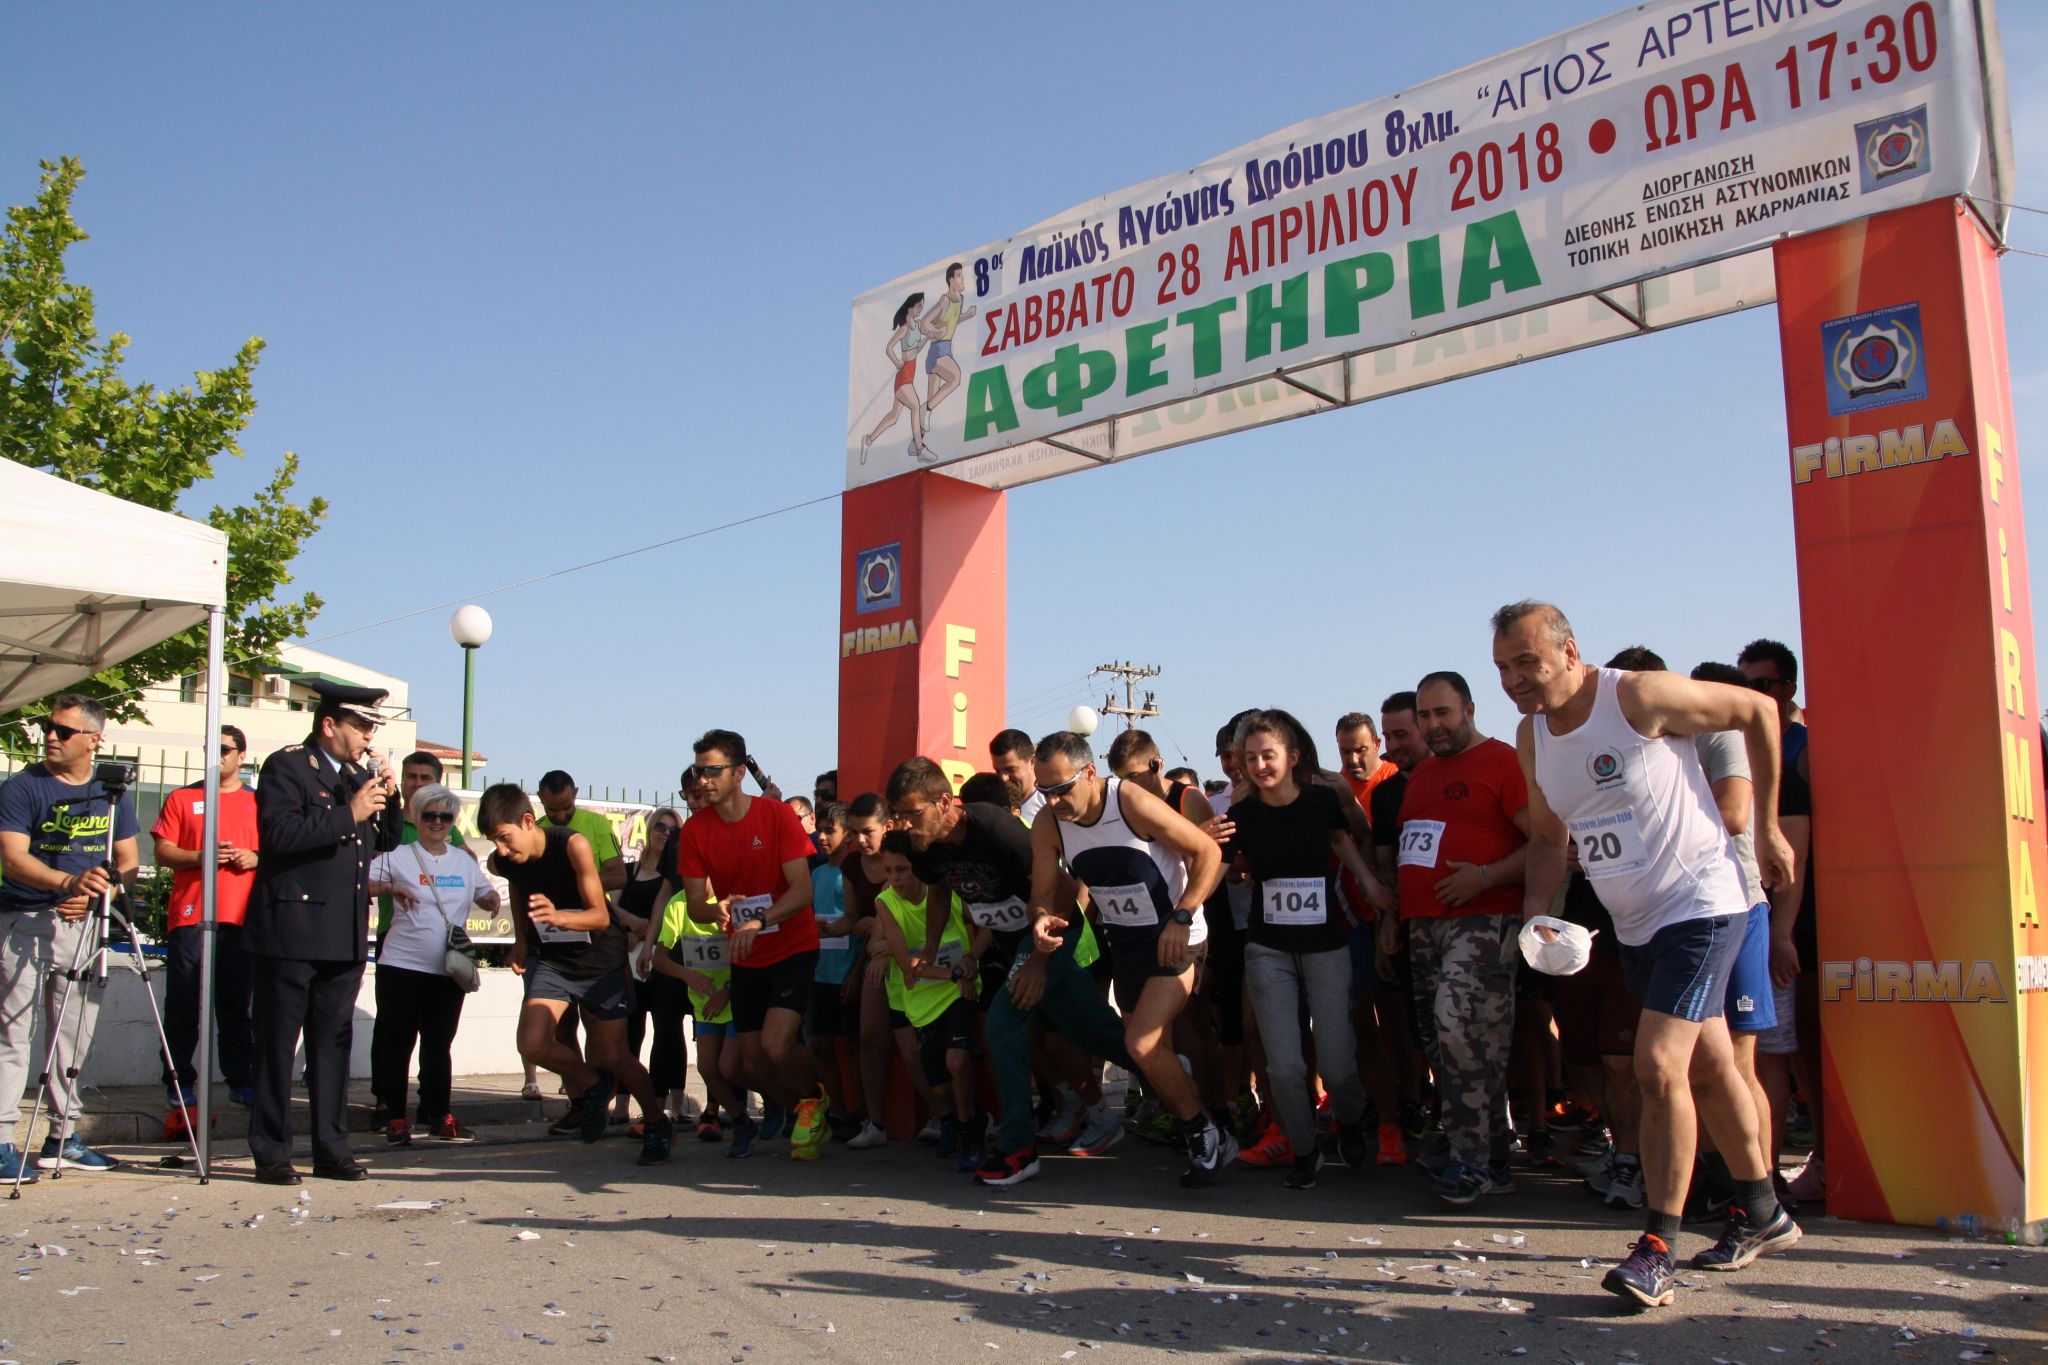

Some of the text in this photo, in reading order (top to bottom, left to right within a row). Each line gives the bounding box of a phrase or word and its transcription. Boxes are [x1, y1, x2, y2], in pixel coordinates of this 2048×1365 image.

[981, 1, 1938, 357] ΣΑΒΒΑΤΟ 28 ΑΠΡΙΛΙΟΥ 2018 ΩΡΑ 17:30
[1642, 154, 1755, 200] ΔΙΟΡΓΑΝΩΣΗ
[1018, 220, 1110, 285] Λαϊκός
[1117, 178, 1235, 250] Αγώνας
[1246, 128, 1369, 206] Δρόμου
[1384, 109, 1460, 158] 8χλμ.
[1564, 155, 1851, 246] ΔΙΕΘΝΗΣ ΕΝΩΣΗ ΑΣΤΥΝΟΜΙΚΩΝ
[1568, 180, 1851, 268] ΤΟΠΙΚΗ ΔΙΟΙΚΗΣΗ ΑΚΑΡΝΑΝΙΑΣ
[964, 209, 1542, 443] ΑΦΕΤΗΡΙΑ
[42, 805, 110, 839] Legend
[1401, 832, 1434, 852] 173
[1583, 832, 1622, 862] 20
[979, 905, 1025, 927] 210
[1107, 898, 1139, 915] 14
[1271, 891, 1320, 912] 104
[695, 945, 720, 961] 16
